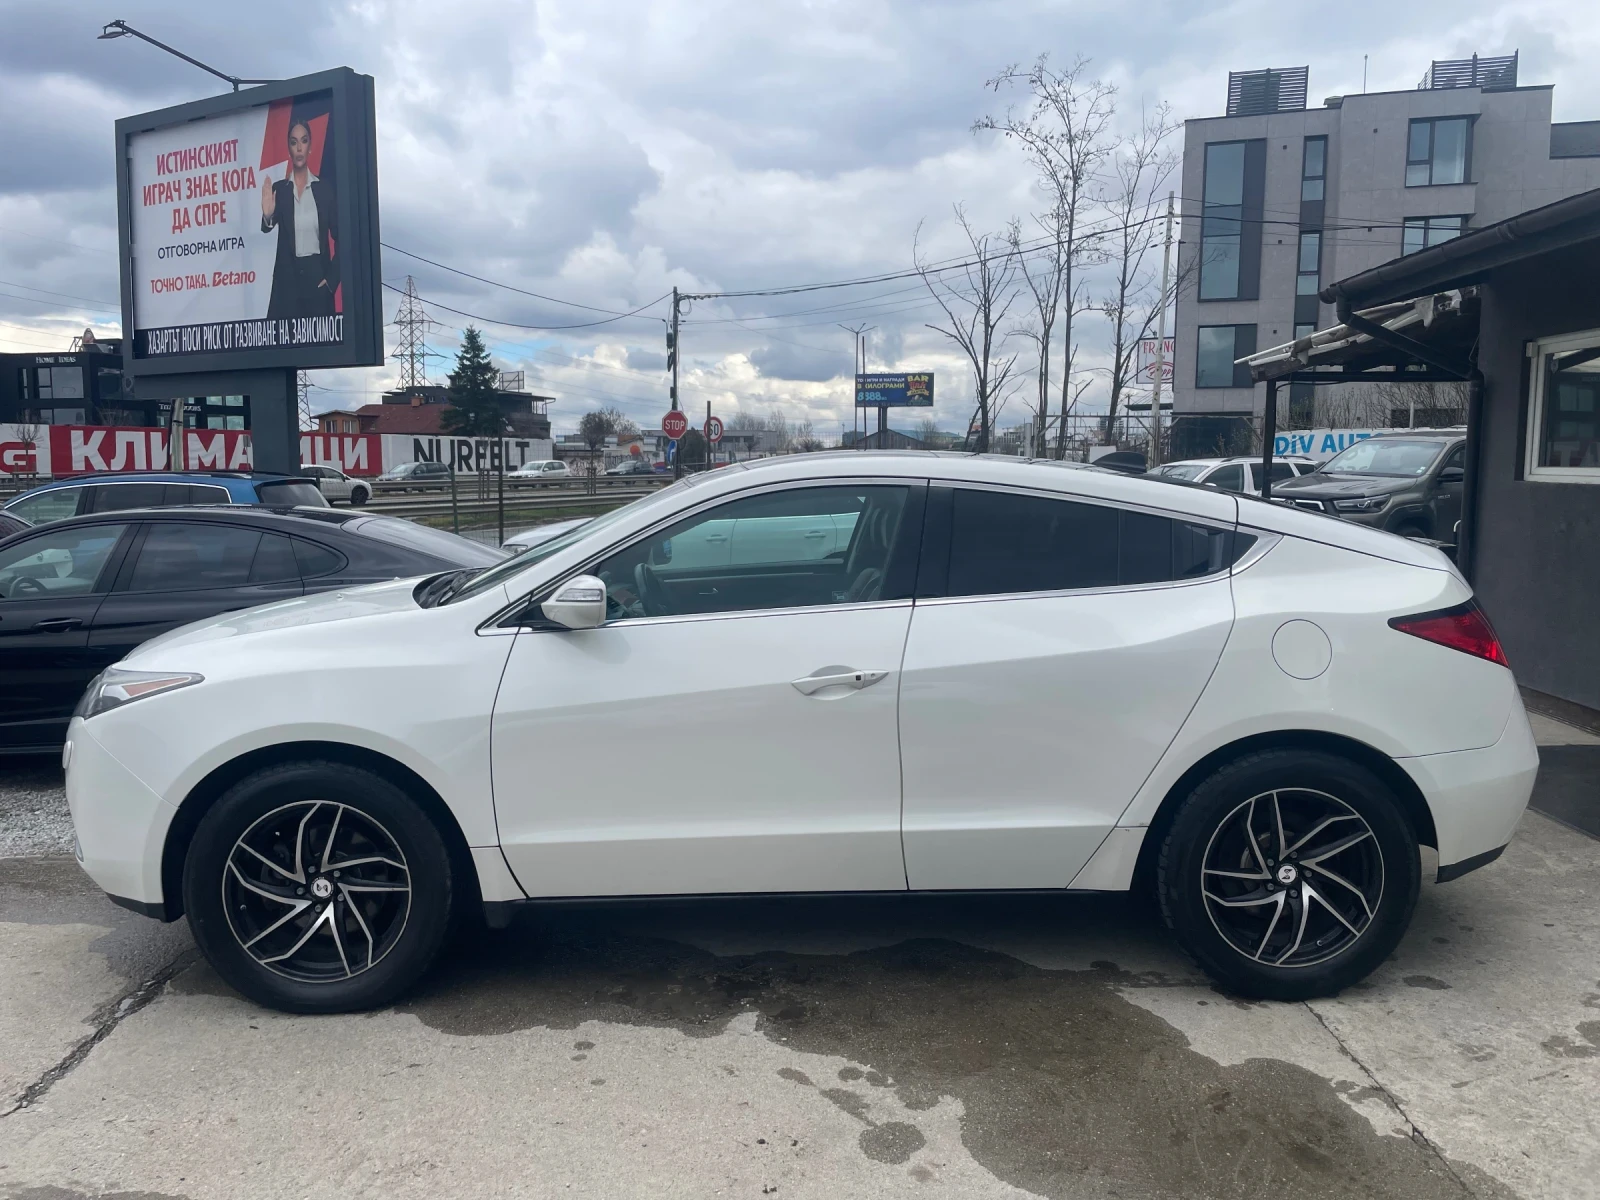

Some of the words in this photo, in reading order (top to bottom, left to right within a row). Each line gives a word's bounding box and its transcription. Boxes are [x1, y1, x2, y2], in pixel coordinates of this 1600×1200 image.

[156, 139, 239, 176] ИСТИНСКИЯТ
[143, 180, 182, 206] ИГРАЧ
[185, 173, 218, 200] ЗНАЕ
[222, 166, 257, 193] КОГА
[172, 207, 191, 234] ДА
[194, 201, 227, 227] СПРЕ
[157, 240, 217, 259] ОТГОВОРНА
[218, 236, 245, 251] ИГРА
[150, 276, 183, 294] ТОЧНО
[185, 273, 210, 290] ТАКА.
[212, 270, 256, 287] Betano
[147, 328, 180, 354] ХАЗАРТЪТ
[182, 326, 201, 352] НОСИ
[203, 325, 222, 350] РИСК
[223, 323, 233, 349] ОТ
[235, 320, 277, 348] РАЗВИВАНЕ
[279, 319, 290, 345] НА
[292, 315, 344, 343] ЗАВИСИМОСТ
[665, 420, 685, 430] STOP
